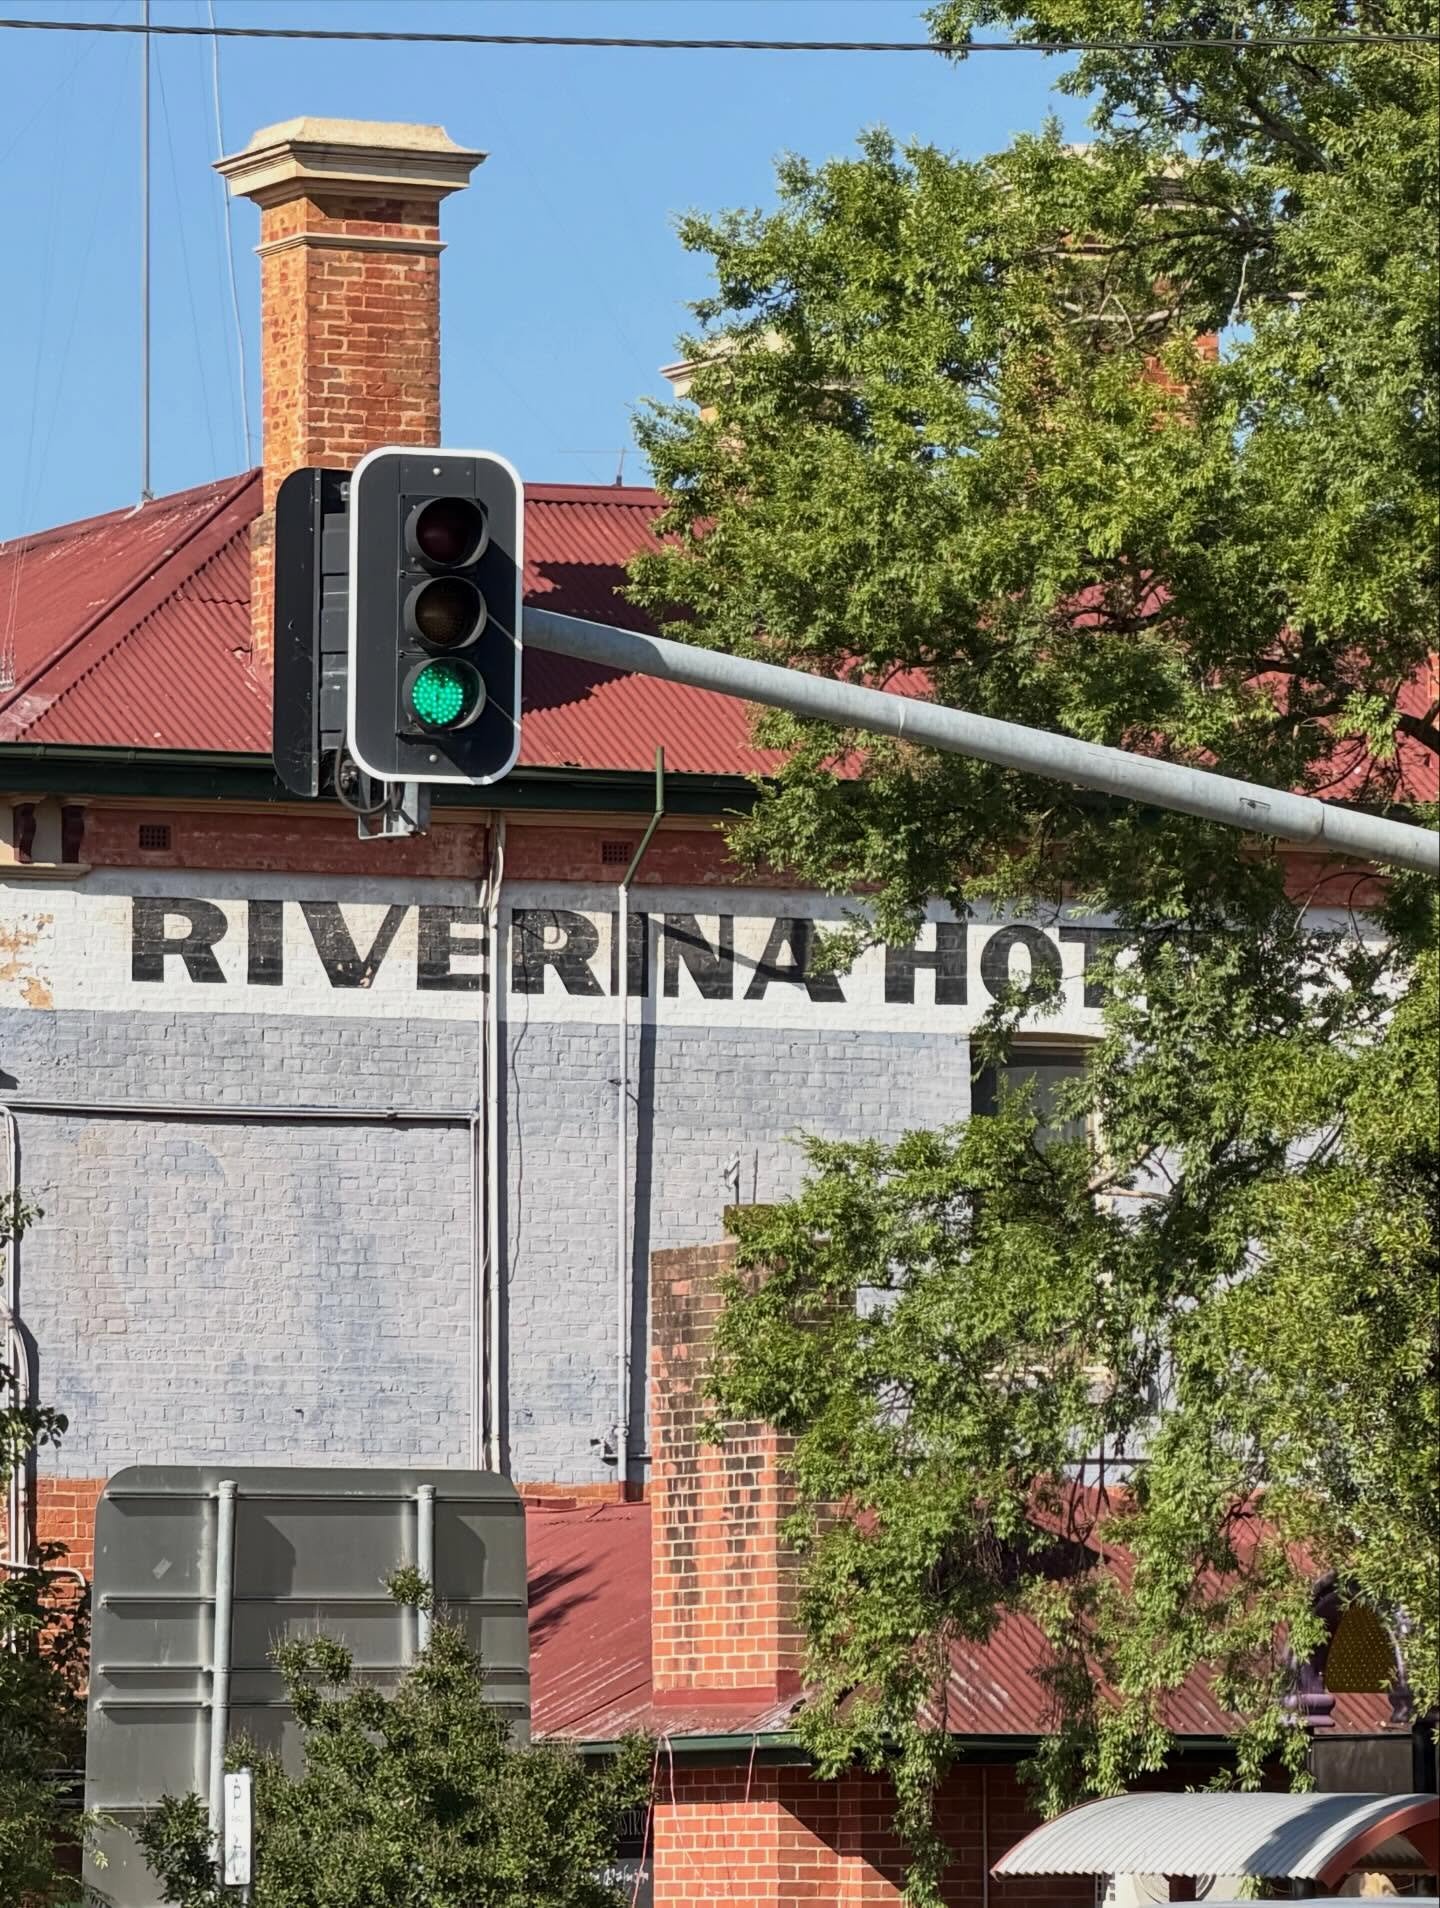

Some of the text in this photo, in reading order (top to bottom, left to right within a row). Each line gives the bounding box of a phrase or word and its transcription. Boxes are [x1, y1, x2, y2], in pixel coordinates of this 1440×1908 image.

[131, 896, 1180, 1009] RIVERINA HOT
[233, 1784, 242, 1809] P
[616, 1809, 648, 1836] STRO
